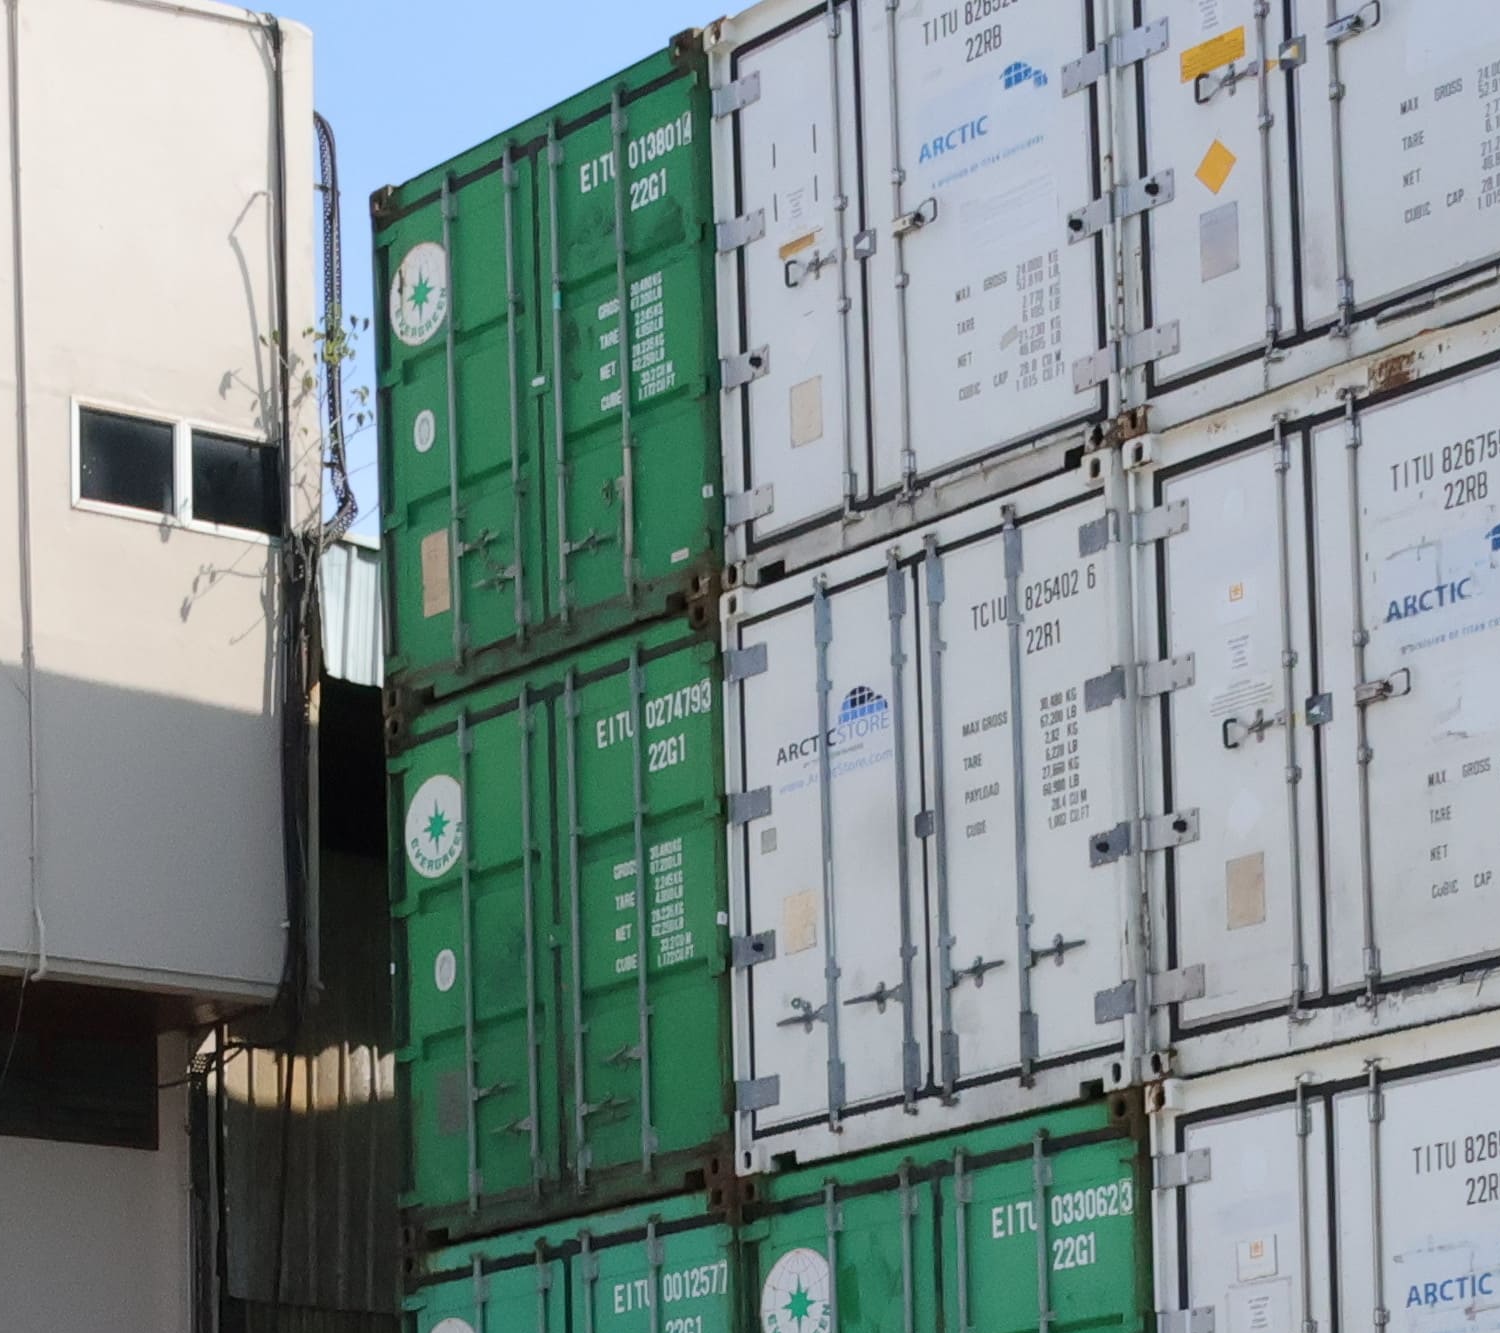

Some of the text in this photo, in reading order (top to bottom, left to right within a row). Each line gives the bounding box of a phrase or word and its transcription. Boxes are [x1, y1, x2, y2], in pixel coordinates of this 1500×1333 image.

[922, 8, 958, 46] TITU
[966, 25, 1002, 63] 22RB
[919, 115, 989, 164] ARCTIC
[630, 169, 667, 212] 22G1
[1390, 452, 1434, 492] TITU
[1444, 471, 1488, 510] 22RB
[971, 564, 1096, 631] TCIU 825402 6
[1384, 578, 1472, 623] ARCTIC
[1026, 619, 1061, 655] 22R1
[597, 711, 633, 749] EITU
[649, 734, 685, 772] 22G1
[1413, 1141, 1456, 1174] TITU
[992, 1201, 1037, 1239] EITU
[1052, 1232, 1096, 1271] 22G1
[663, 1260, 728, 1303] 0012577
[1406, 1272, 1492, 1308] ARCTIC
